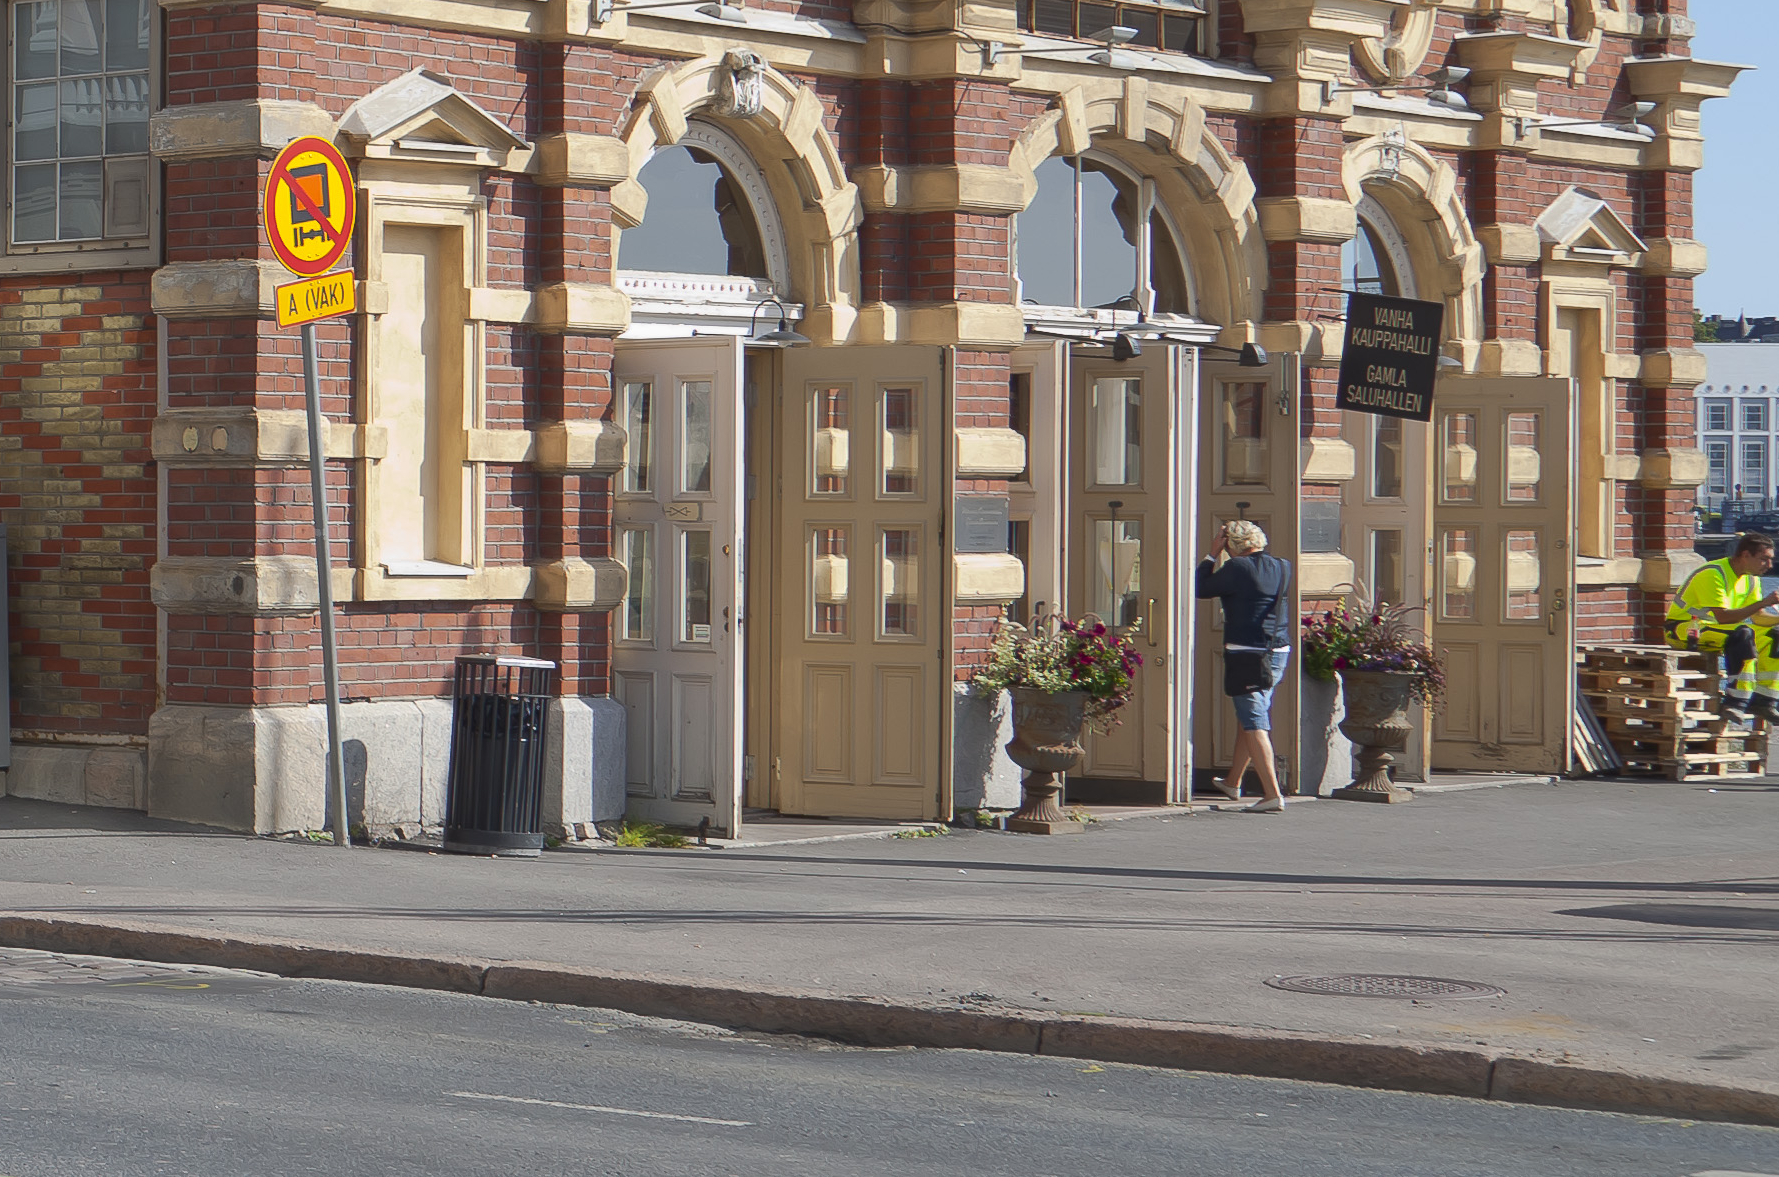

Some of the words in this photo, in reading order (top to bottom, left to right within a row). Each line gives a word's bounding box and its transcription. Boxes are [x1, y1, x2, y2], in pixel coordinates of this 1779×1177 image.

[288, 292, 298, 316] A
[305, 281, 345, 312] (VAK)
[1373, 306, 1414, 330] VANHA
[1351, 327, 1432, 355] KAUPPAHALLI
[1366, 364, 1407, 388] GAMLA
[1345, 384, 1423, 412] SALUHALLEN
